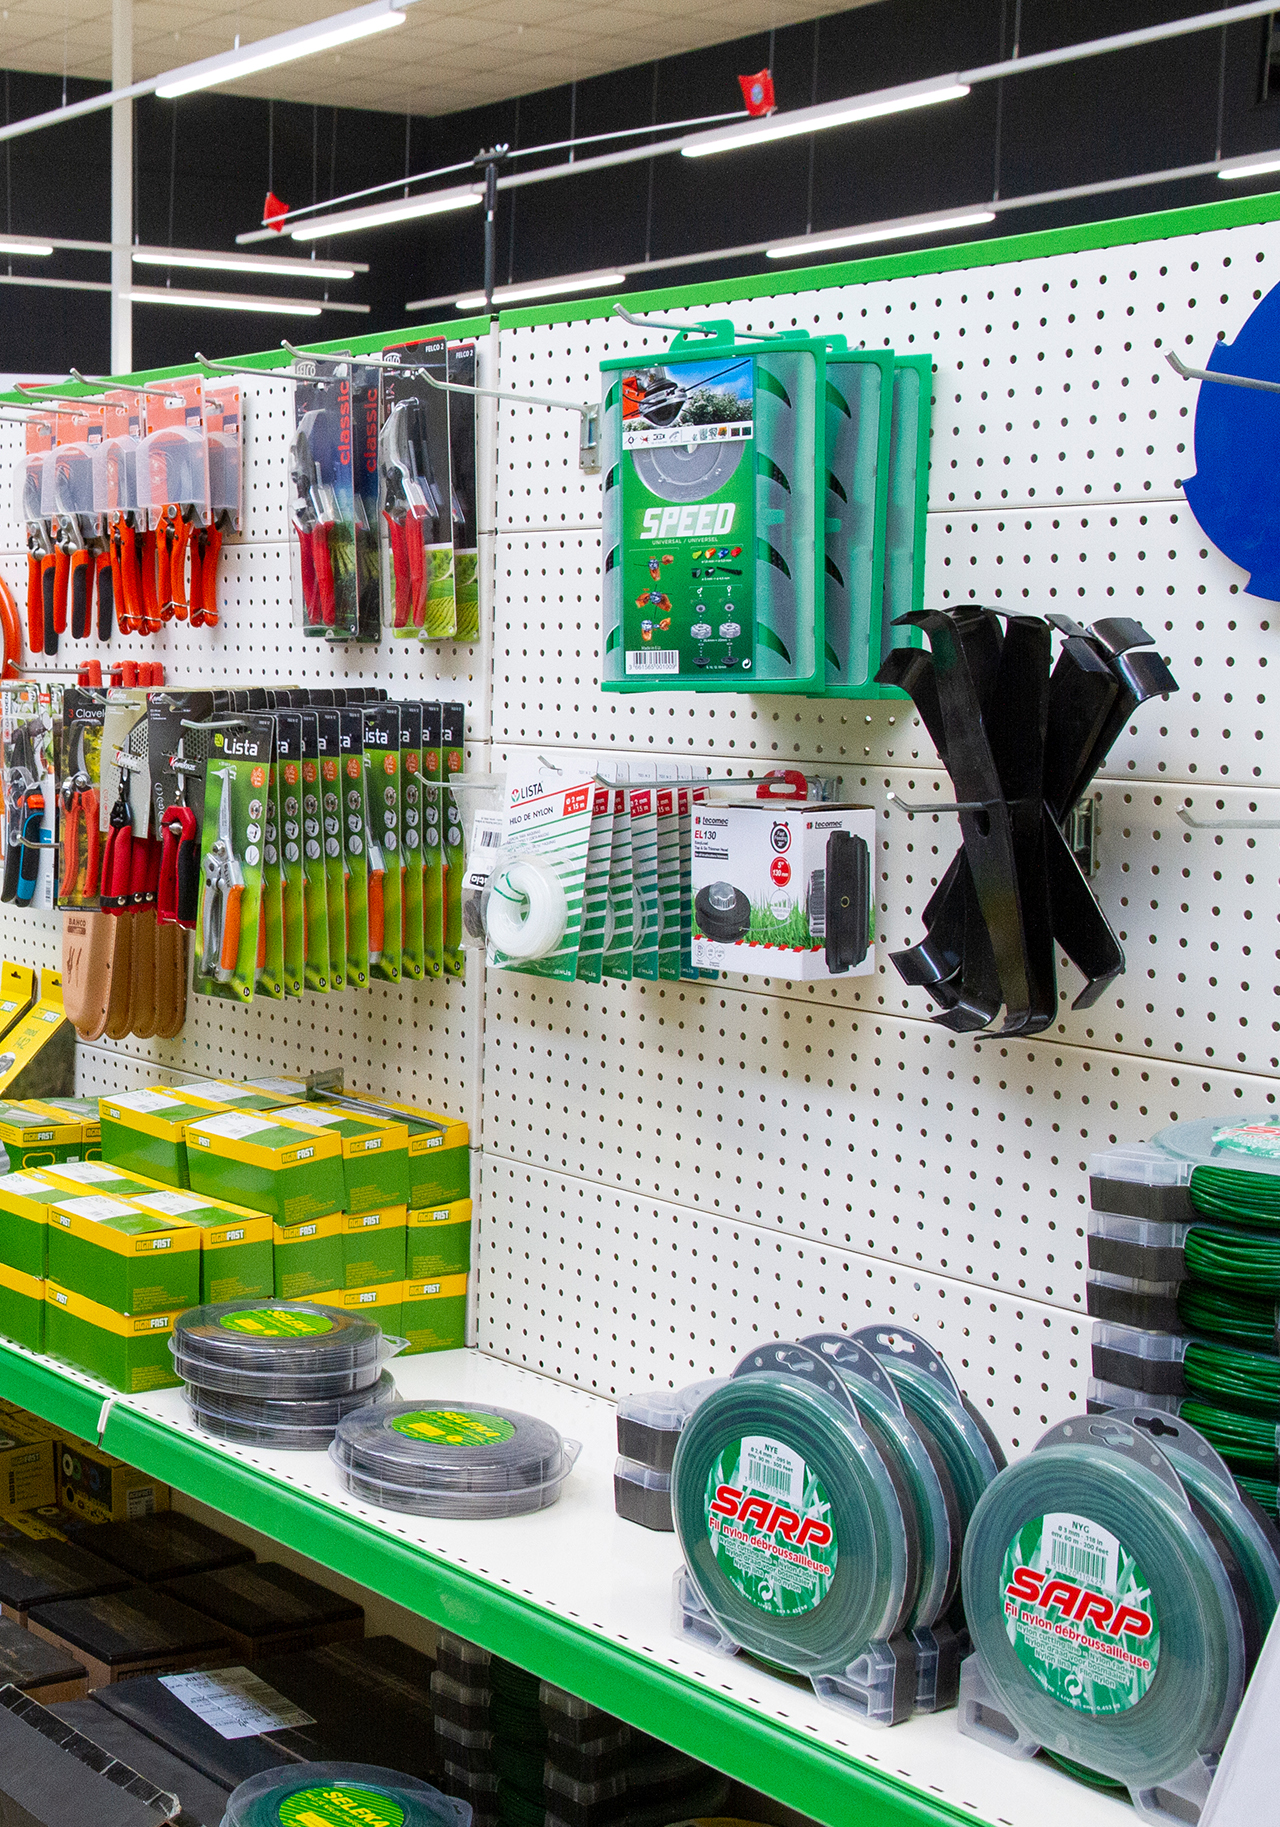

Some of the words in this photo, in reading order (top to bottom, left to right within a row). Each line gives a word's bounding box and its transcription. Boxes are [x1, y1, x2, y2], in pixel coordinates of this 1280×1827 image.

[426, 344, 439, 352] FELCO
[456, 351, 469, 359] FELCO
[338, 380, 350, 465] classic
[364, 388, 378, 472] classic
[640, 503, 736, 539] SPEED
[68, 709, 74, 718] 3
[76, 708, 104, 718] Clavel
[224, 738, 258, 756] Lista
[521, 783, 543, 799] LISTA
[510, 815, 522, 825] HILO
[533, 806, 554, 817] NYLON
[703, 817, 728, 825] tecomec
[815, 821, 842, 829] tecomec
[134, 1317, 168, 1331] AGRIFAST
[765, 1444, 778, 1454] NYE
[710, 1485, 831, 1545] SARP
[1072, 1521, 1089, 1534] NYG
[709, 1517, 720, 1530] Fil
[724, 1525, 748, 1542] nylon
[751, 1536, 829, 1575] débroussailleuse
[1051, 1531, 1063, 1539] env.
[1084, 1542, 1094, 1550] 200
[1096, 1546, 1108, 1556] feet
[1008, 1568, 1150, 1636] SARP
[1005, 1602, 1018, 1617] Fil
[1022, 1611, 1052, 1631] nylon
[1055, 1624, 1150, 1670] débroussailleuse
[1018, 1624, 1037, 1637] Nylon
[1039, 1632, 1065, 1649] cutting
[1090, 1652, 1110, 1666] Nylon
[1026, 1636, 1045, 1650] Nylon
[1047, 1646, 1068, 1658] draad
[1070, 1654, 1085, 1664] voor
[1088, 1662, 1126, 1682] bosmaaier
[1036, 1649, 1055, 1663] Nylon
[1094, 1674, 1115, 1688] nylon
[323, 1792, 390, 1827] SELEKA
